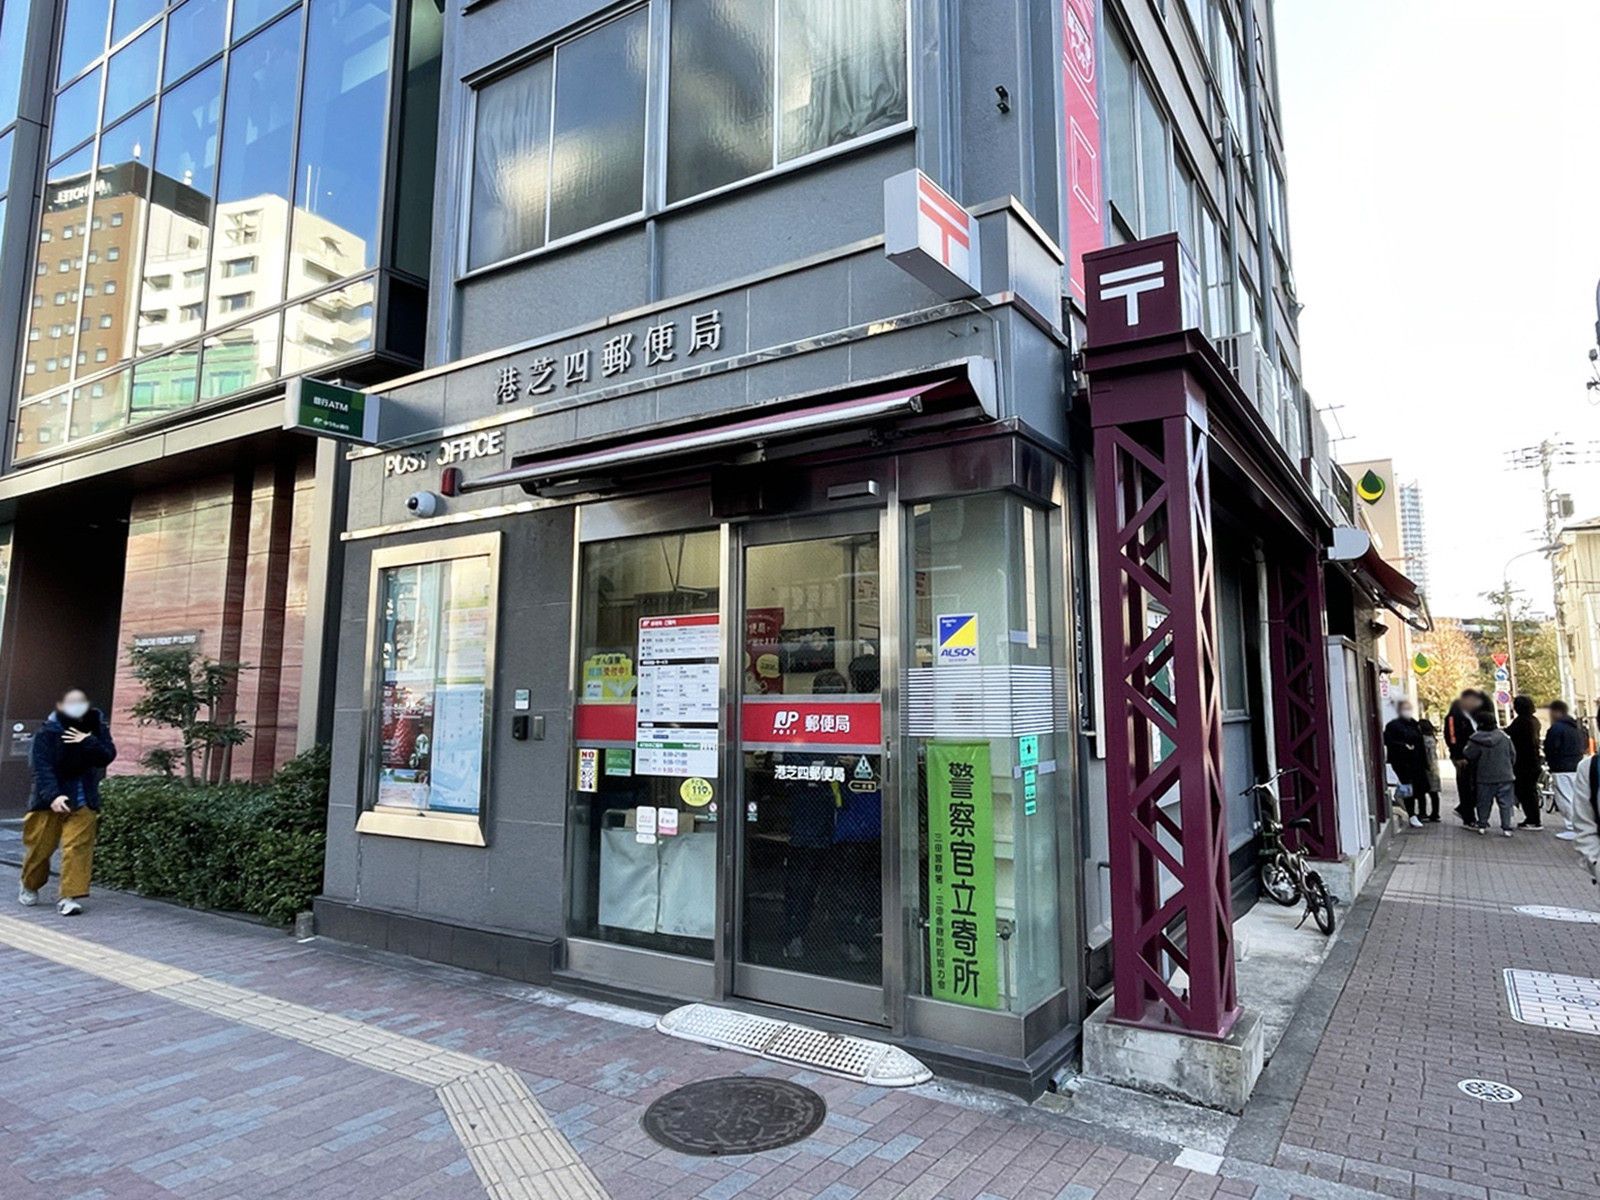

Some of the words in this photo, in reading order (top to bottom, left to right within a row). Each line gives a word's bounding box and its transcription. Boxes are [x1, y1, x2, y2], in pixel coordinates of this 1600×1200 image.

[493, 309, 722, 404] 港芝四郵便局
[385, 450, 431, 477] POST
[437, 430, 502, 465] OFFICE
[940, 647, 976, 658] ALSOK
[805, 714, 851, 733] 郵便局
[774, 765, 845, 782] 港芝四郵便局
[948, 761, 979, 998] 警察官立寄所
